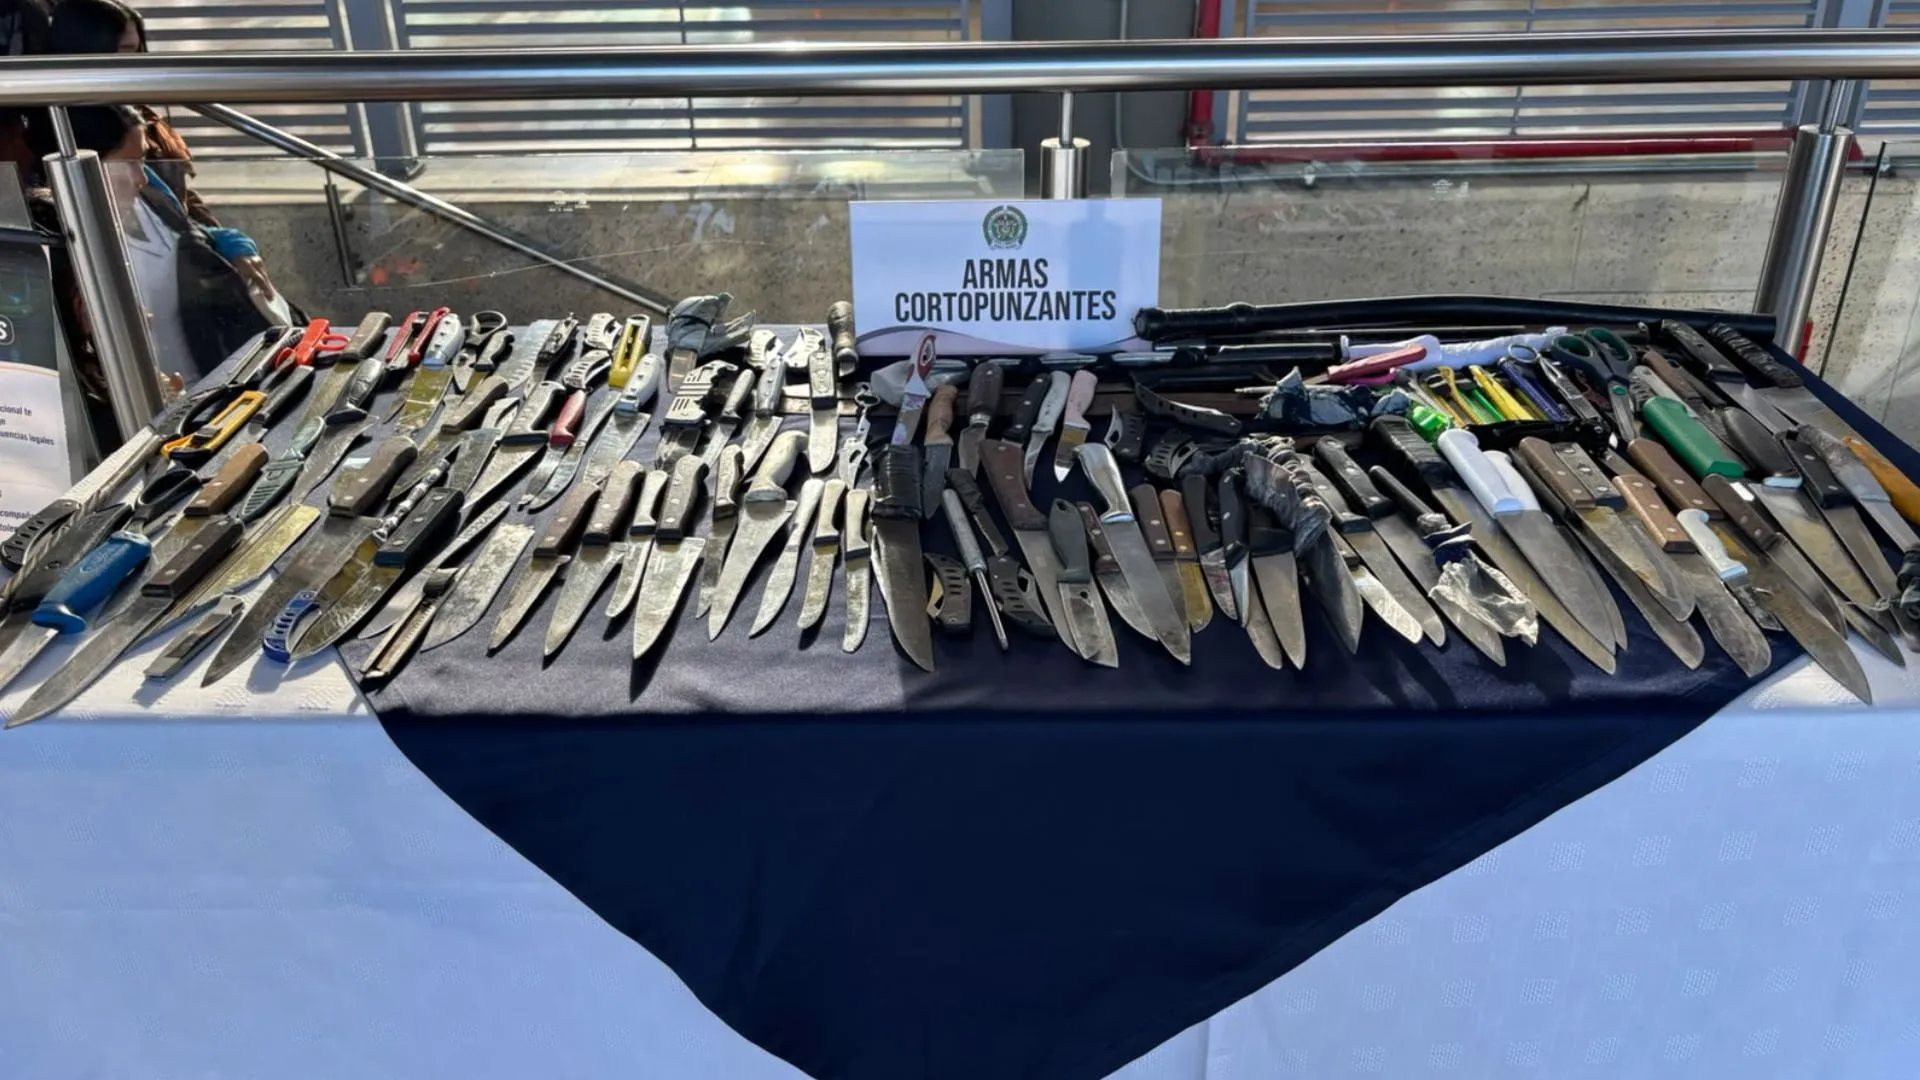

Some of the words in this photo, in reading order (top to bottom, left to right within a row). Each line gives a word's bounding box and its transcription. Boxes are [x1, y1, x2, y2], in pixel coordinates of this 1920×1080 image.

[962, 258, 1049, 289] ARMAS
[895, 290, 1117, 322] CORTOPUNZANTES
[0, 404, 22, 416] cional
[23, 406, 32, 417] te
[0, 430, 28, 441] uencias
[29, 432, 54, 446] legales
